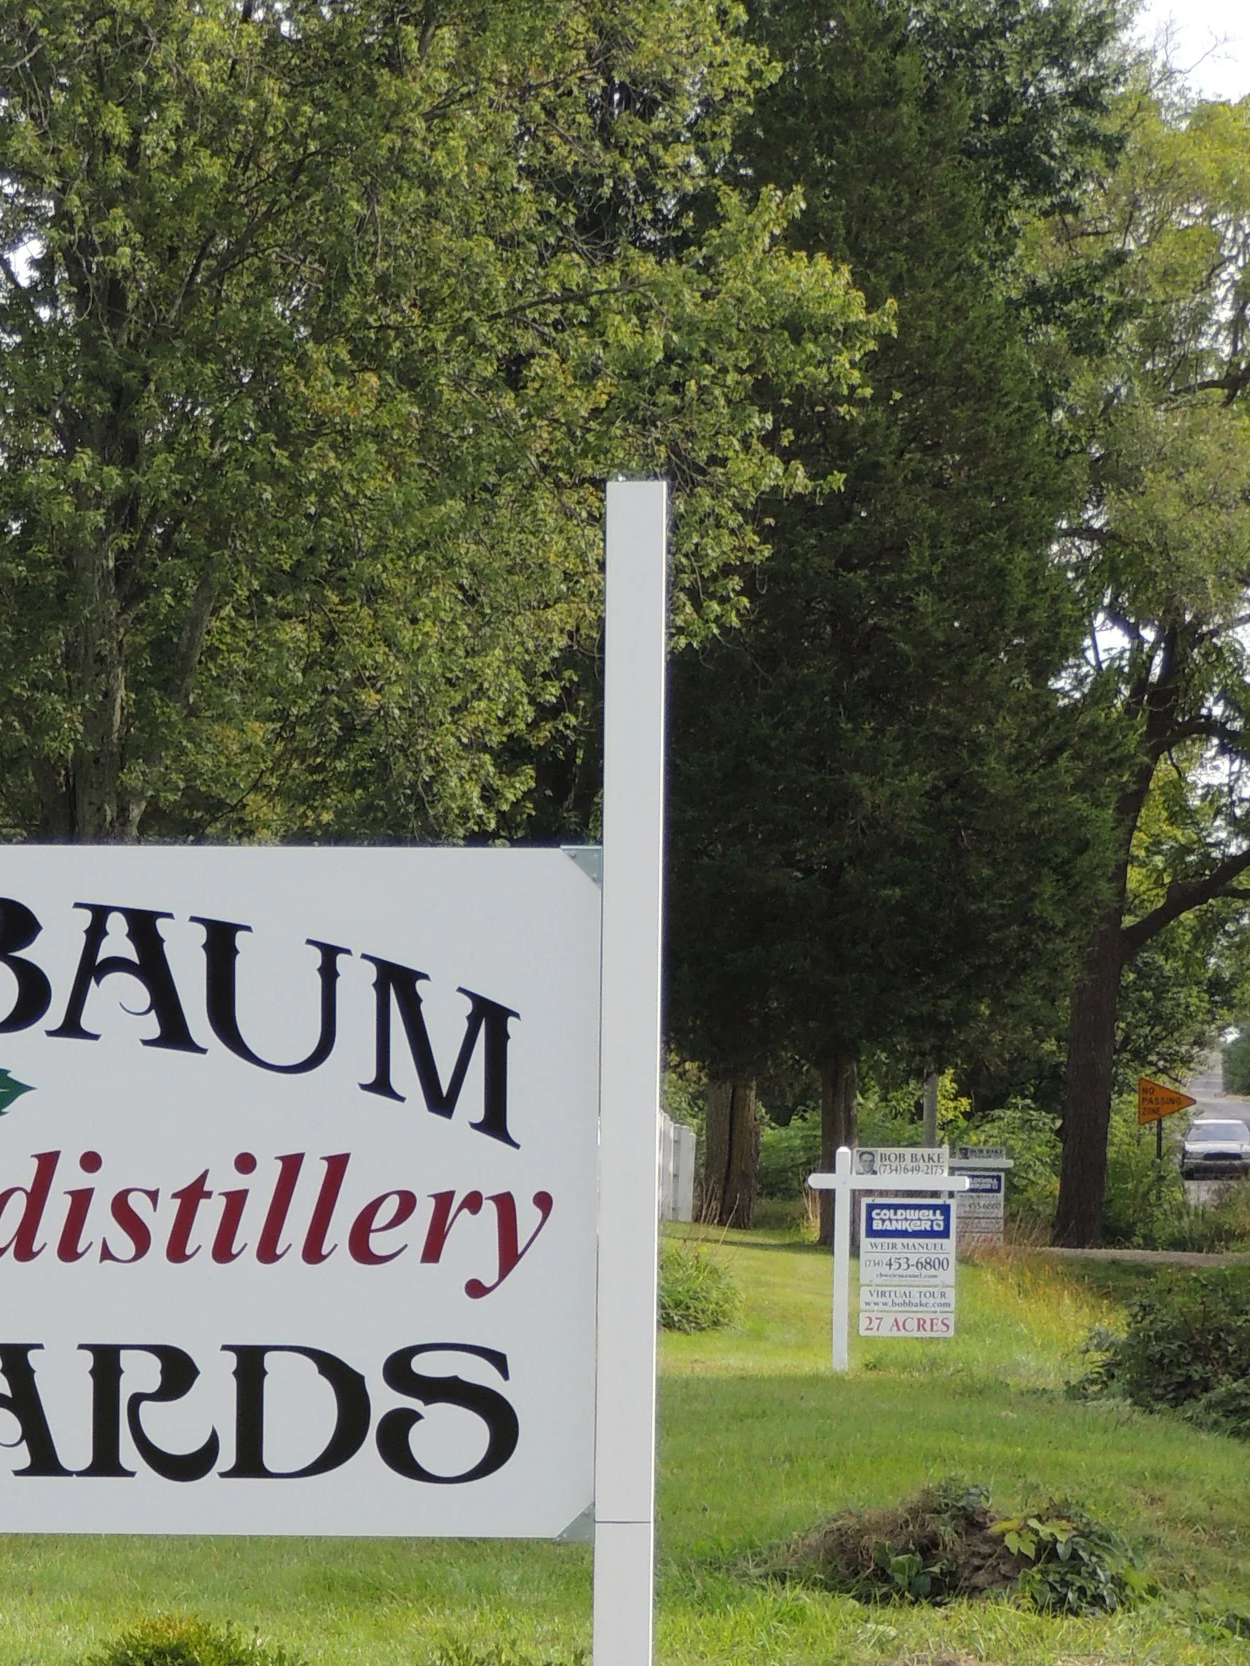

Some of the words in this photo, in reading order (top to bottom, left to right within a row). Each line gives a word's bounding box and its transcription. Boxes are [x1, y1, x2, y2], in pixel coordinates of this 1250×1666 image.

[1141, 1087, 1154, 1095] NO
[1141, 1096, 1182, 1105] PASSING
[879, 1152, 906, 1163] BOB
[910, 1152, 945, 1163] BAKE
[871, 1208, 945, 1220] COLDWELL
[872, 1219, 931, 1232] BANKER
[869, 1242, 898, 1251] WEIR
[901, 1242, 946, 1251] MANUEL
[864, 1258, 884, 1269] (734)
[885, 1256, 950, 1272] 453-6800
[868, 1289, 914, 1299] VIRTUAL
[916, 1290, 947, 1299] TOUR
[864, 1299, 951, 1309] www.bobbake.com
[864, 1315, 884, 1332] 27
[889, 1316, 950, 1333] ACRES
